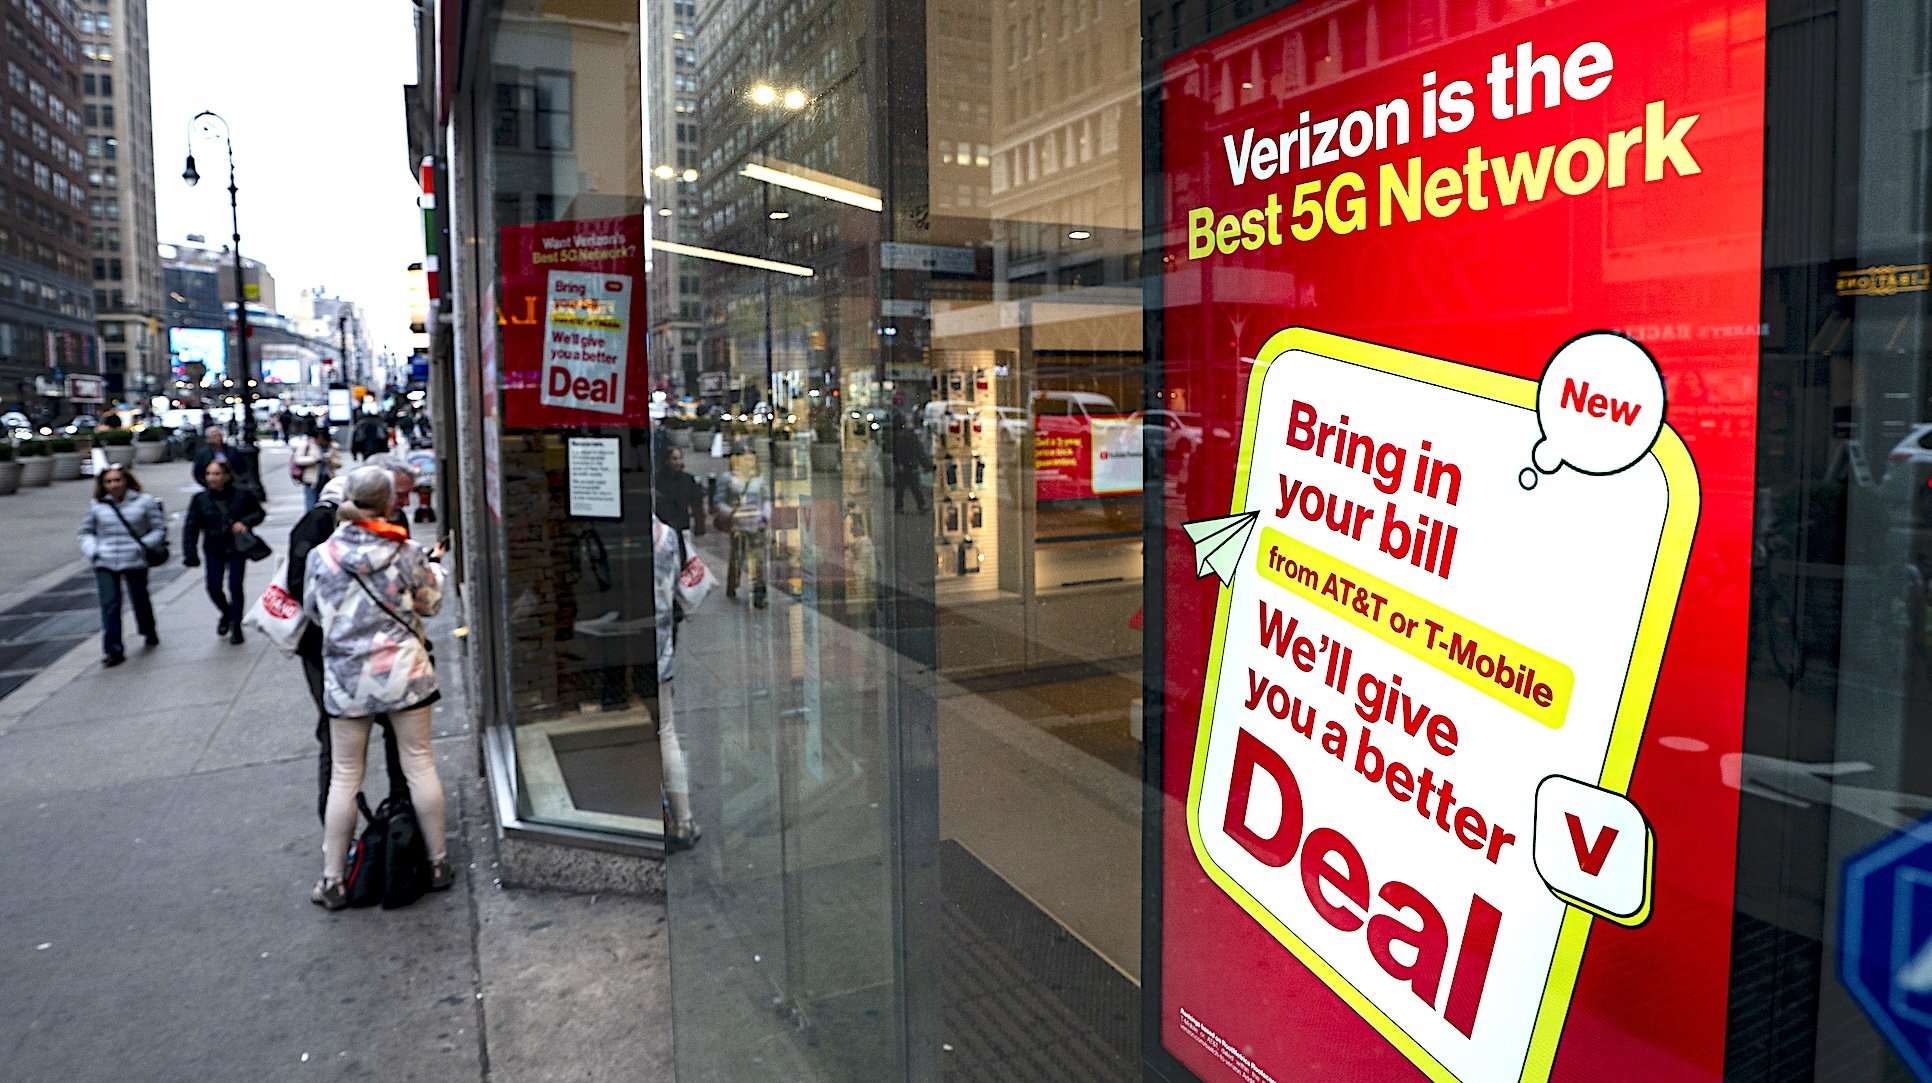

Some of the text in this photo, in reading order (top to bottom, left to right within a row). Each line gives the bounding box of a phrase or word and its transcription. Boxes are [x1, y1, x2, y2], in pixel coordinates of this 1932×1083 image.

[1223, 39, 1614, 187] Verizon is the
[1187, 99, 1702, 260] Best 5G Network
[532, 251, 559, 265] Best
[555, 281, 585, 297] Bring
[549, 367, 617, 403] Deal
[551, 348, 571, 360] you
[582, 349, 618, 364] better
[581, 334, 607, 348] give
[1286, 399, 1462, 506] Bring in
[1560, 377, 1643, 427] New
[1275, 473, 1458, 579] your bill
[1259, 599, 1458, 756] We'll give
[1269, 545, 1554, 708] from AT&T or T-Mobile
[1244, 667, 1516, 864] you a better
[1222, 726, 1503, 1041] Deal
